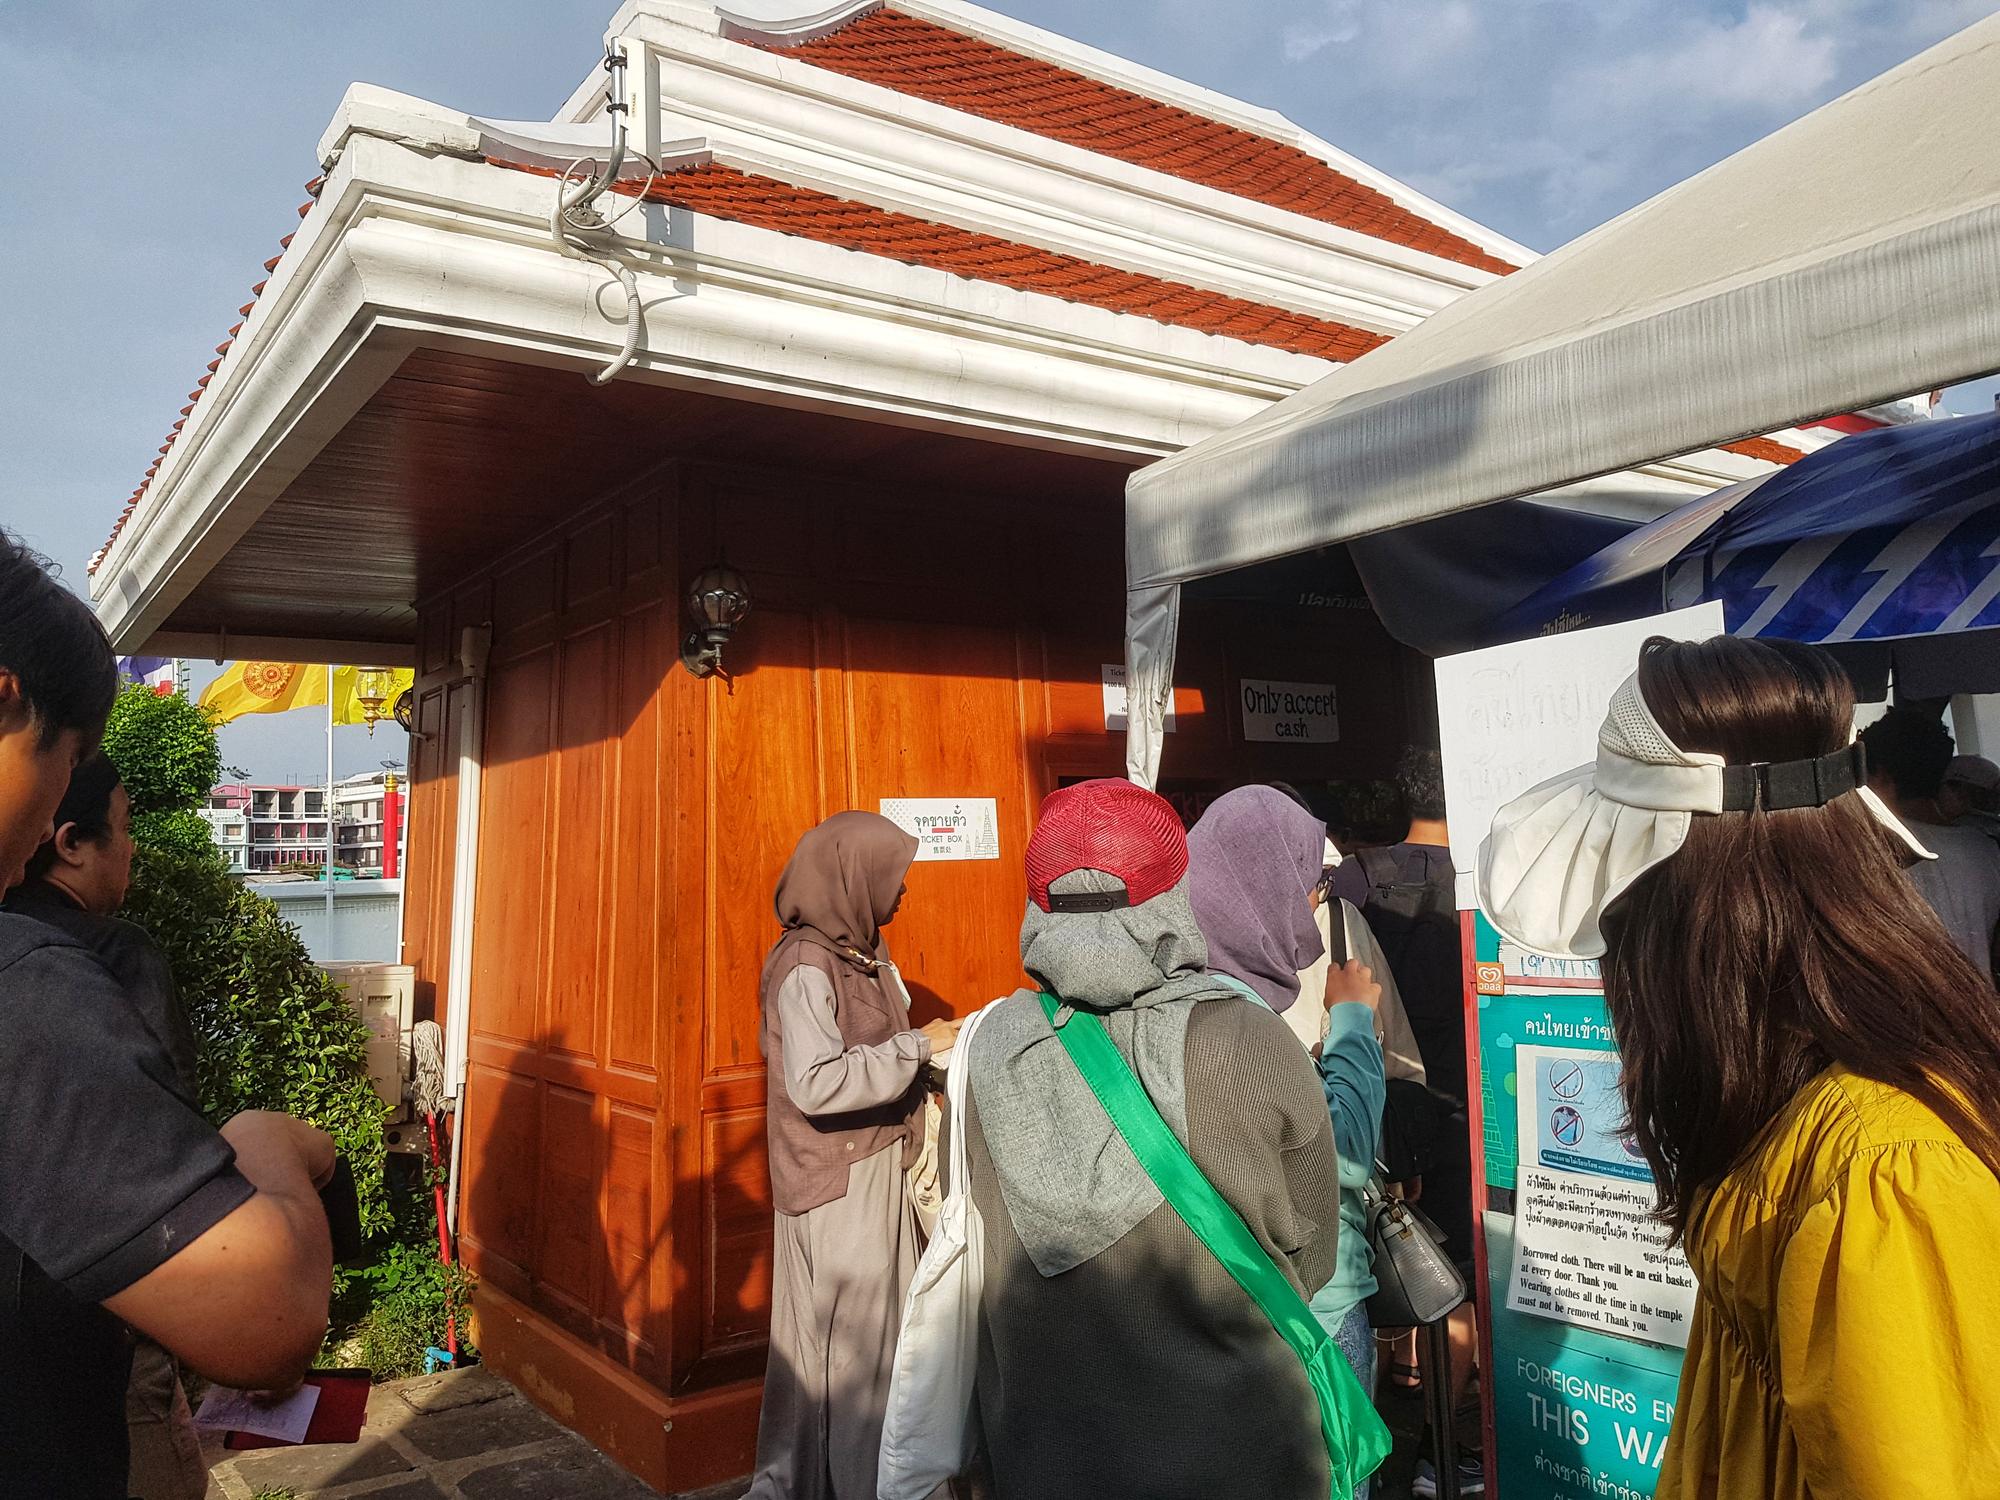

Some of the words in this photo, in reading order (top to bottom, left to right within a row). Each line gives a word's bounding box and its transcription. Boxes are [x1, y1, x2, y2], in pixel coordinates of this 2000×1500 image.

[1244, 684, 1282, 714] Only
[1284, 690, 1336, 716] accept
[1275, 718, 1309, 737] cash
[914, 804, 967, 833] จุดขายตั๋ว
[921, 835, 943, 843] TICKET
[947, 835, 963, 843] BOX
[1520, 1264, 1529, 1273] at
[1531, 1267, 1551, 1279] every
[1554, 1269, 1574, 1282] door.
[1576, 1273, 1600, 1287] Thank
[1603, 1281, 1619, 1292] you.
[1522, 1245, 1558, 1262] Borrowed
[1560, 1253, 1581, 1267] cloth.
[1583, 1257, 1605, 1271] There
[1608, 1262, 1621, 1275] will
[1624, 1264, 1633, 1277] be
[1636, 1271, 1645, 1280] an
[1648, 1271, 1662, 1283] exit
[1665, 1273, 1692, 1288] basket
[1517, 1295, 1536, 1307] must
[1539, 1299, 1551, 1311] not
[1554, 1301, 1564, 1313] be
[1567, 1307, 1601, 1321] removed.
[1604, 1311, 1629, 1328] Thank
[1632, 1320, 1648, 1331] you.
[1520, 1277, 1552, 1296] Wearing
[1554, 1286, 1580, 1300] clothes
[1582, 1291, 1592, 1302] all
[1595, 1293, 1607, 1306] the
[1610, 1296, 1627, 1309] time
[1629, 1300, 1638, 1312] in
[1640, 1303, 1653, 1315] the
[1655, 1305, 1683, 1322] temple
[1517, 1357, 1637, 1414] FOREIGNERS
[1527, 1392, 1590, 1445] THIS
